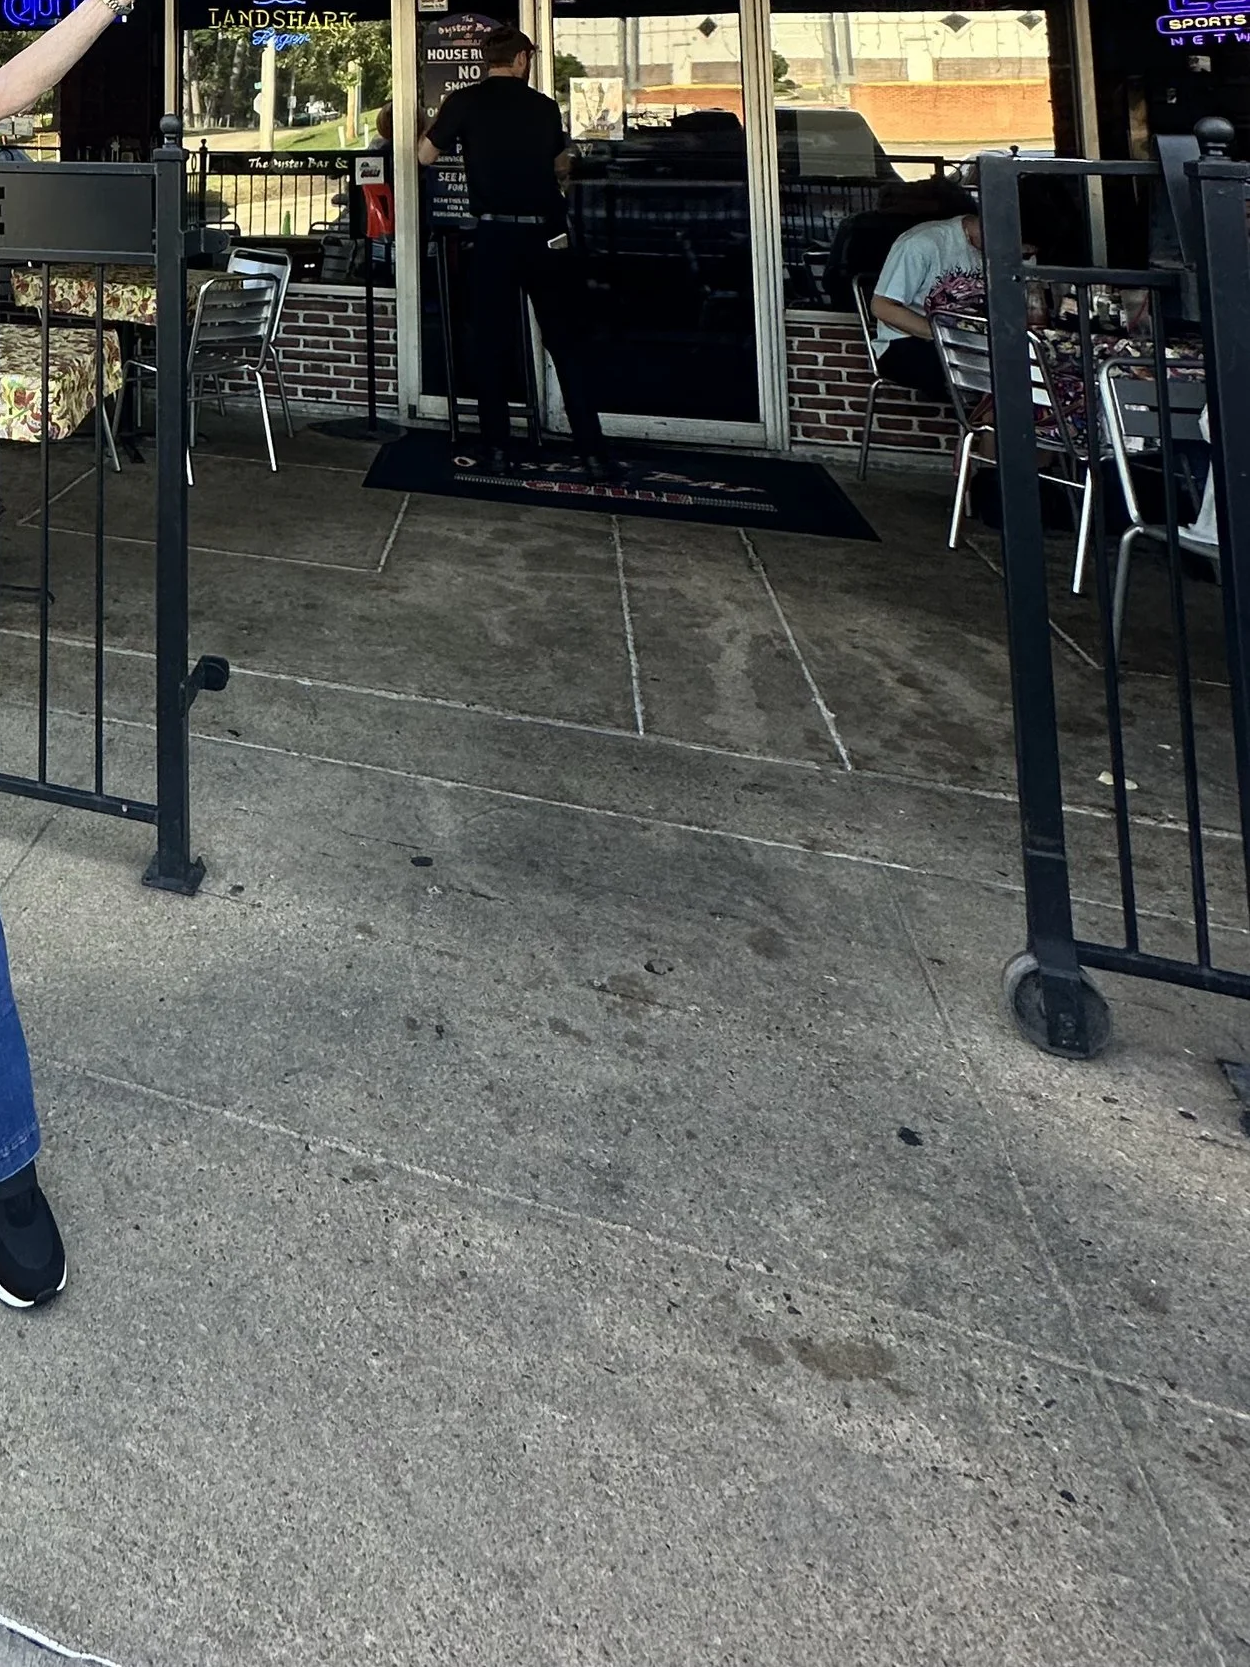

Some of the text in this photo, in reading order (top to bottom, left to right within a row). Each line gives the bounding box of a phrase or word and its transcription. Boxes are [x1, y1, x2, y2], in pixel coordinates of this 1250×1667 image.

[207, 7, 358, 34] LANDSHARK
[1168, 14, 1247, 30] SPORTS
[427, 48, 469, 60] HOUSE
[458, 65, 481, 79] NO
[248, 157, 269, 169] The
[307, 157, 329, 169] Bar
[335, 157, 348, 169] &
